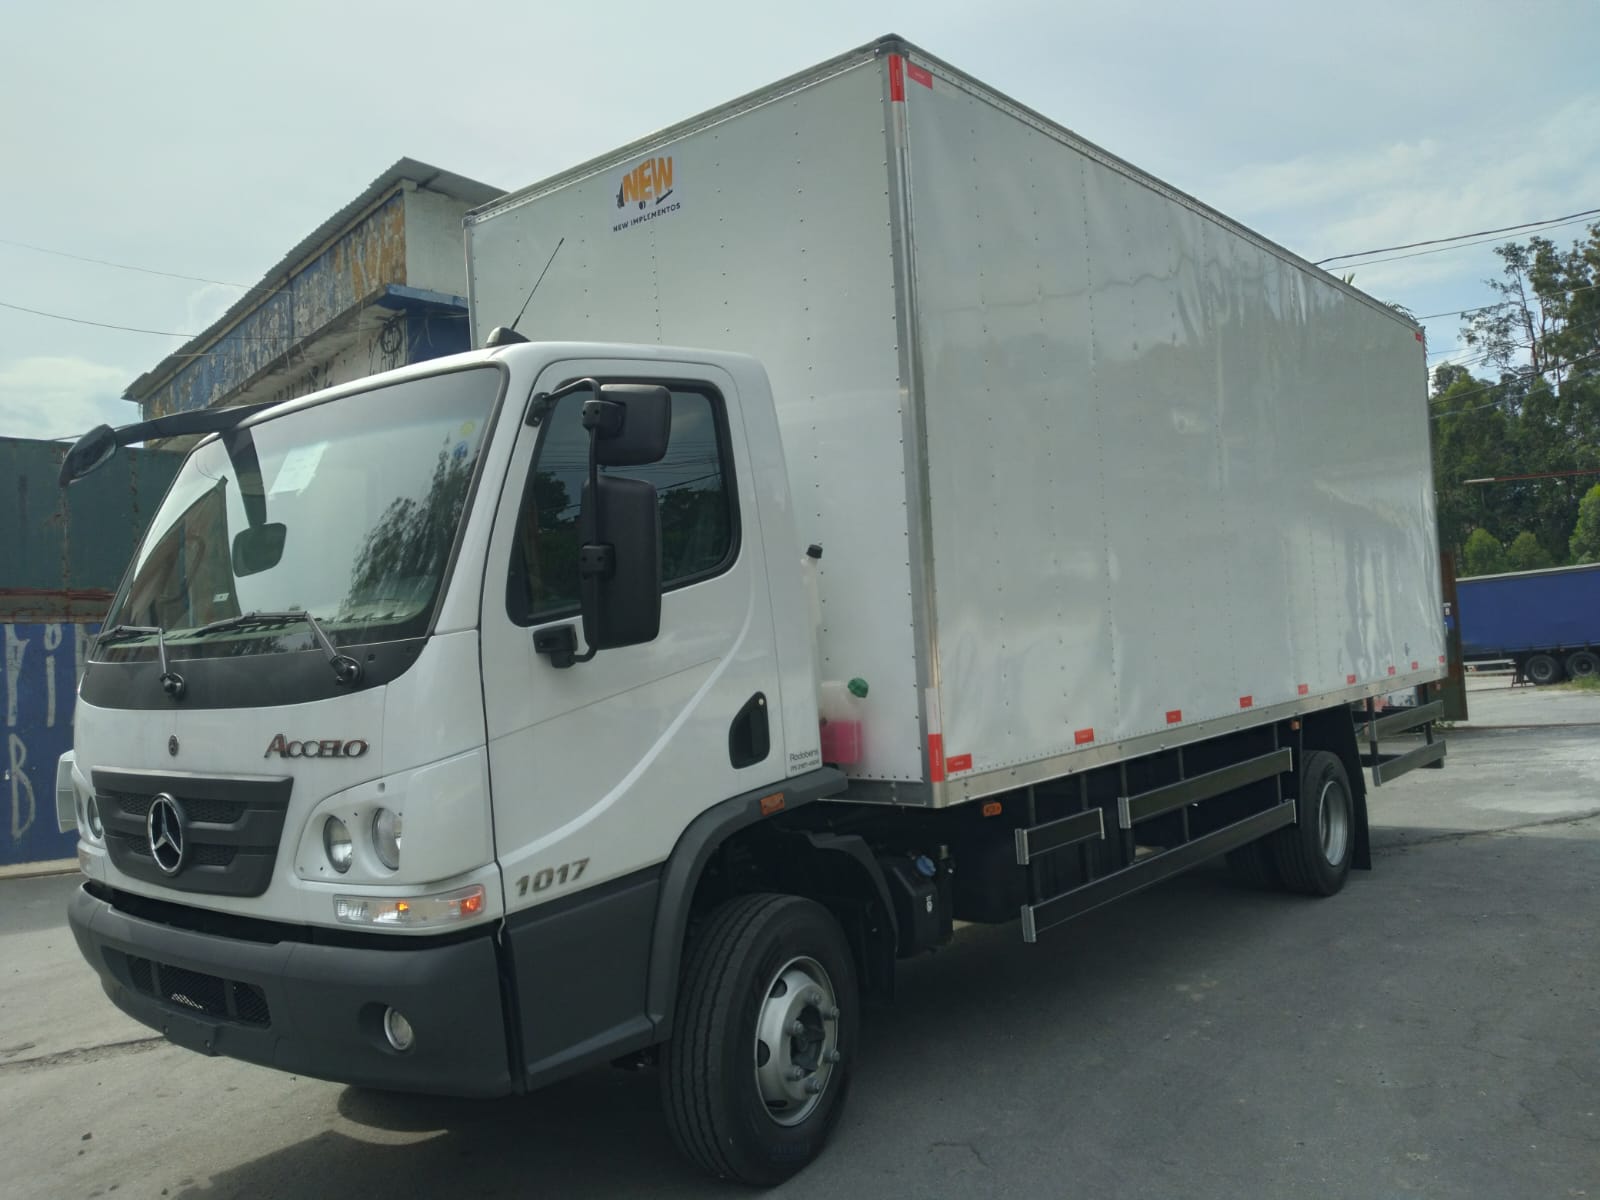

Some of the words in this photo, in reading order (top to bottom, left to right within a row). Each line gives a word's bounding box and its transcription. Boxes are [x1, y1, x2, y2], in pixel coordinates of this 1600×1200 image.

[623, 156, 673, 203] NEW
[613, 221, 628, 232] NEW
[631, 202, 680, 225] IMPLEMENTOS
[515, 856, 590, 897] 1017
